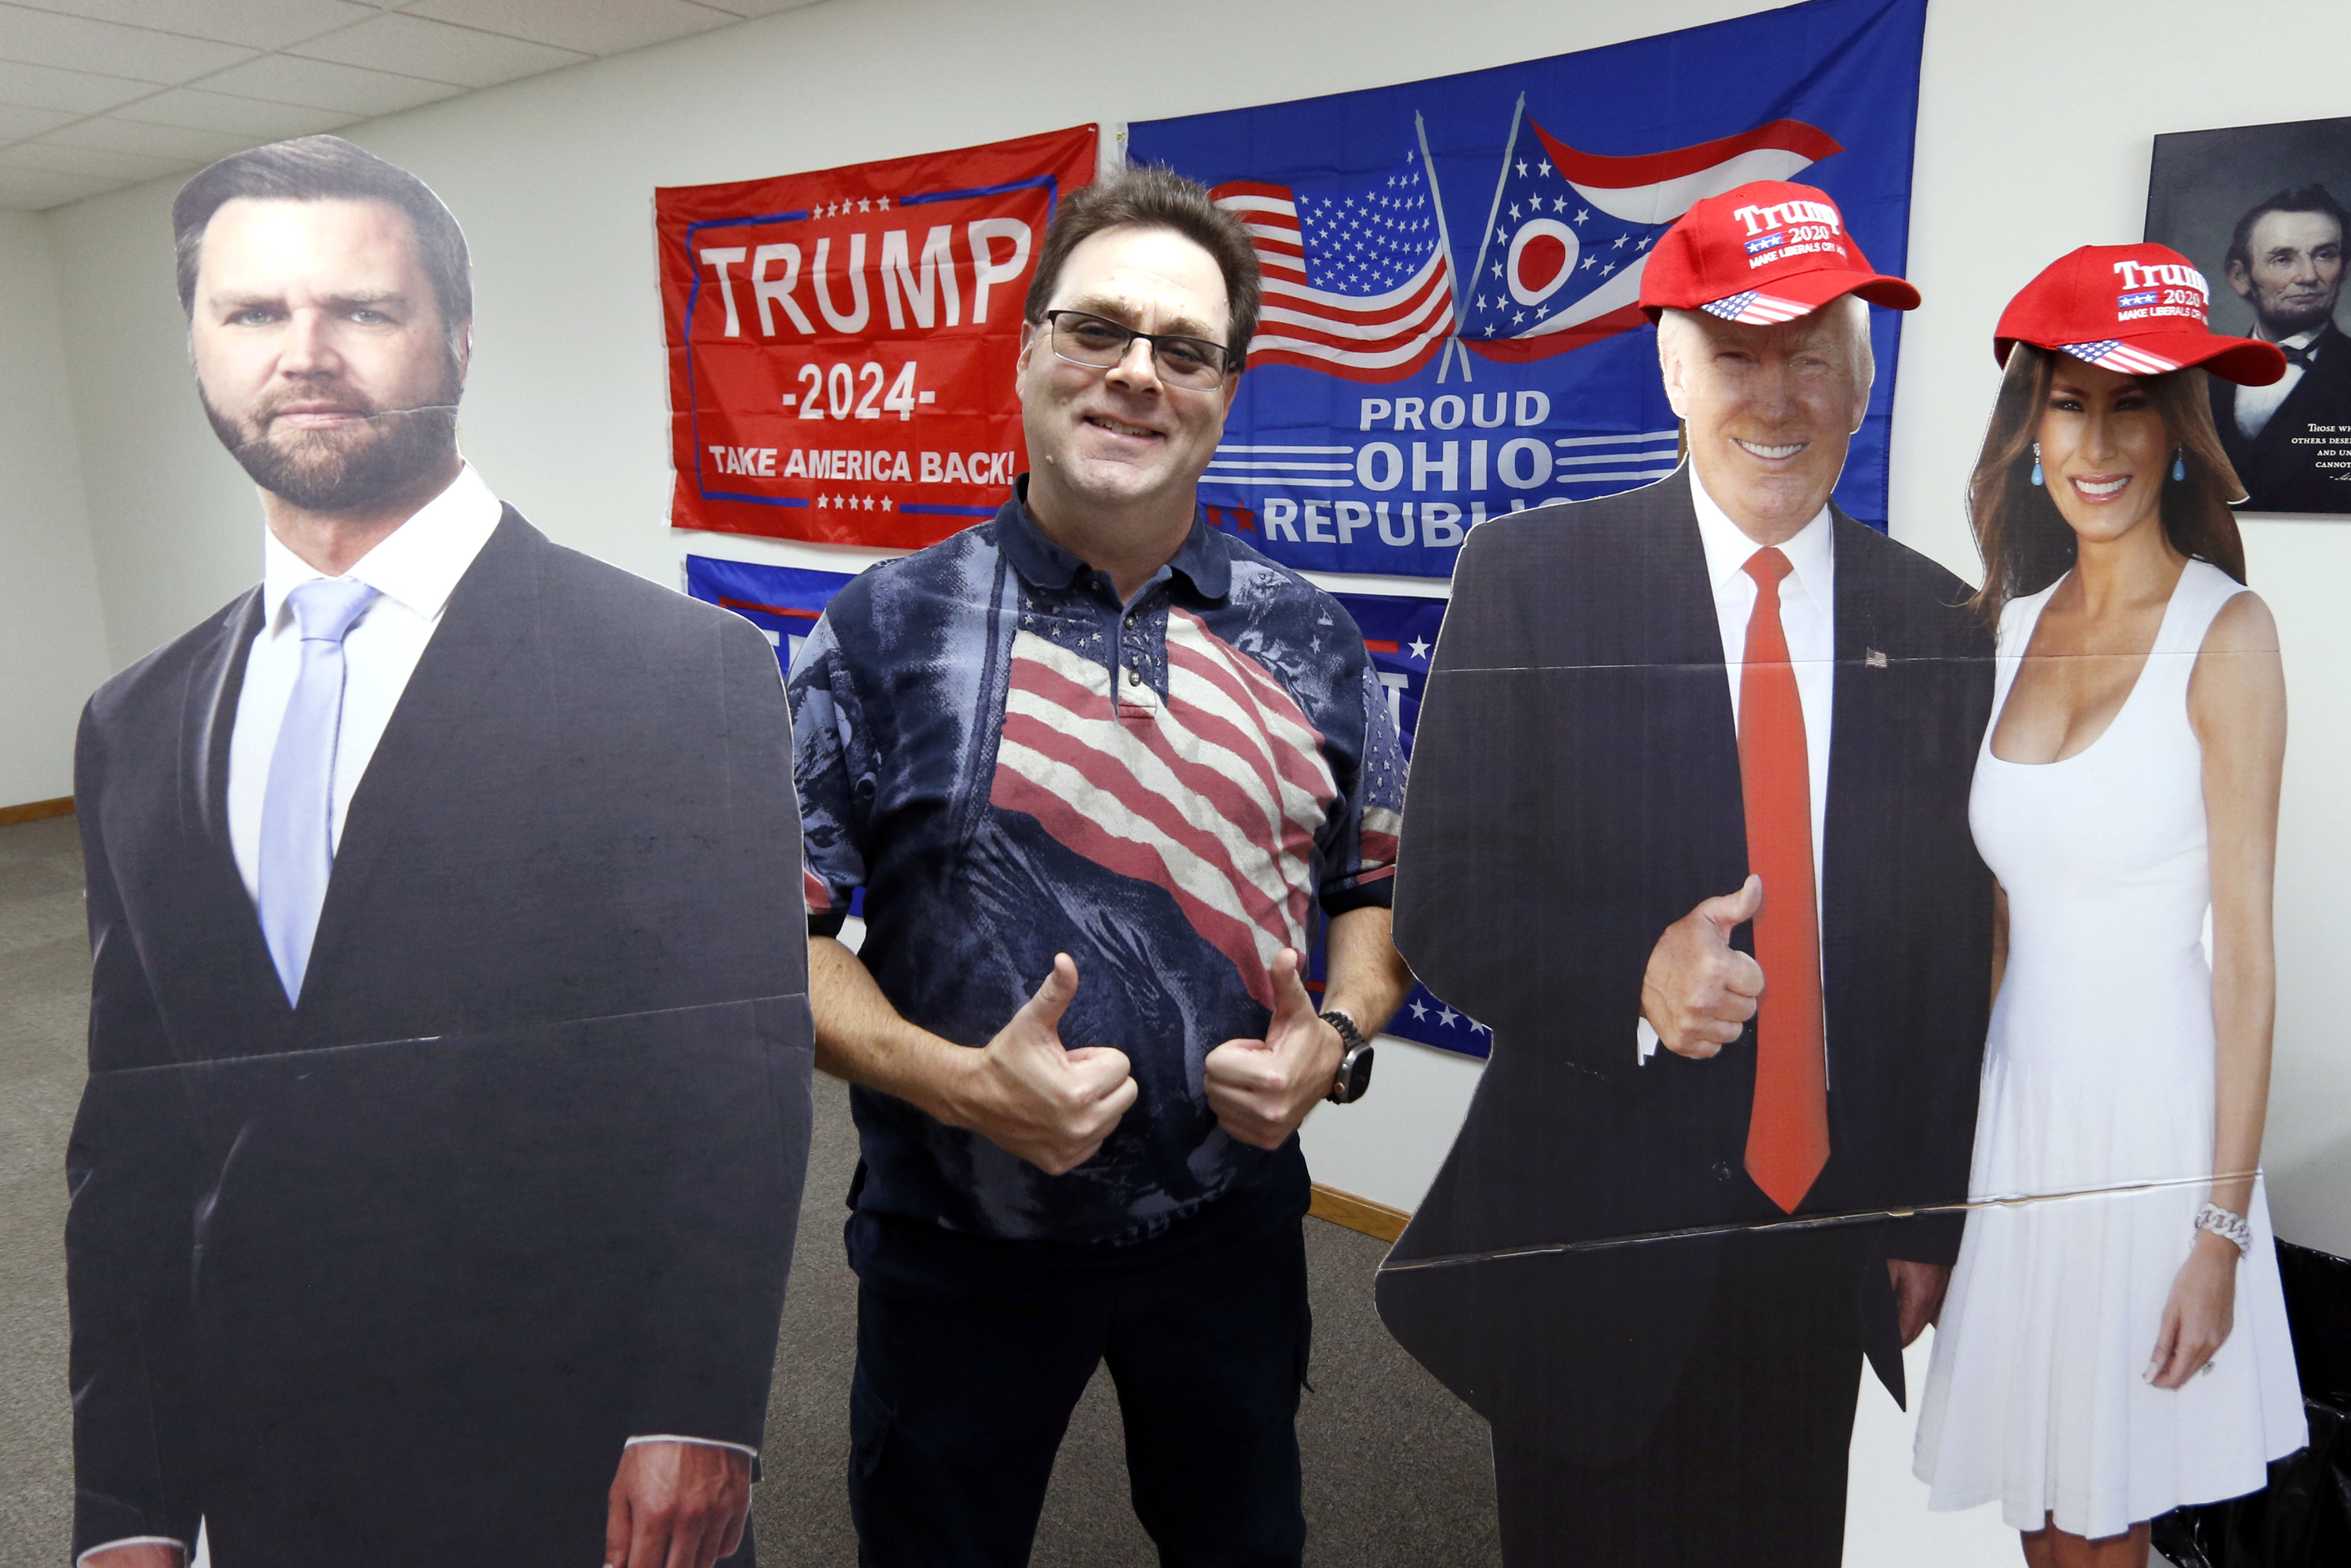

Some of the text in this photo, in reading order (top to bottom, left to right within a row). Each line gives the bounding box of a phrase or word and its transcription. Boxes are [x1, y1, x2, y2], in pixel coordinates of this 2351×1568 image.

[1733, 201, 1840, 237] Trump
[1788, 226, 1829, 244] 2020
[1748, 251, 1779, 270] MAKE
[1778, 242, 1820, 258] LIBERALS
[701, 217, 1032, 338] TRUMP
[2118, 308, 2148, 321] MAKE
[2150, 306, 2190, 317] LIBERALS
[2164, 289, 2201, 307] 2020
[782, 361, 936, 422] -2024-
[1359, 390, 1551, 431] PROUD
[708, 445, 1016, 486] TAKE AMERICA BACK!
[1356, 436, 1553, 492] OHIO
